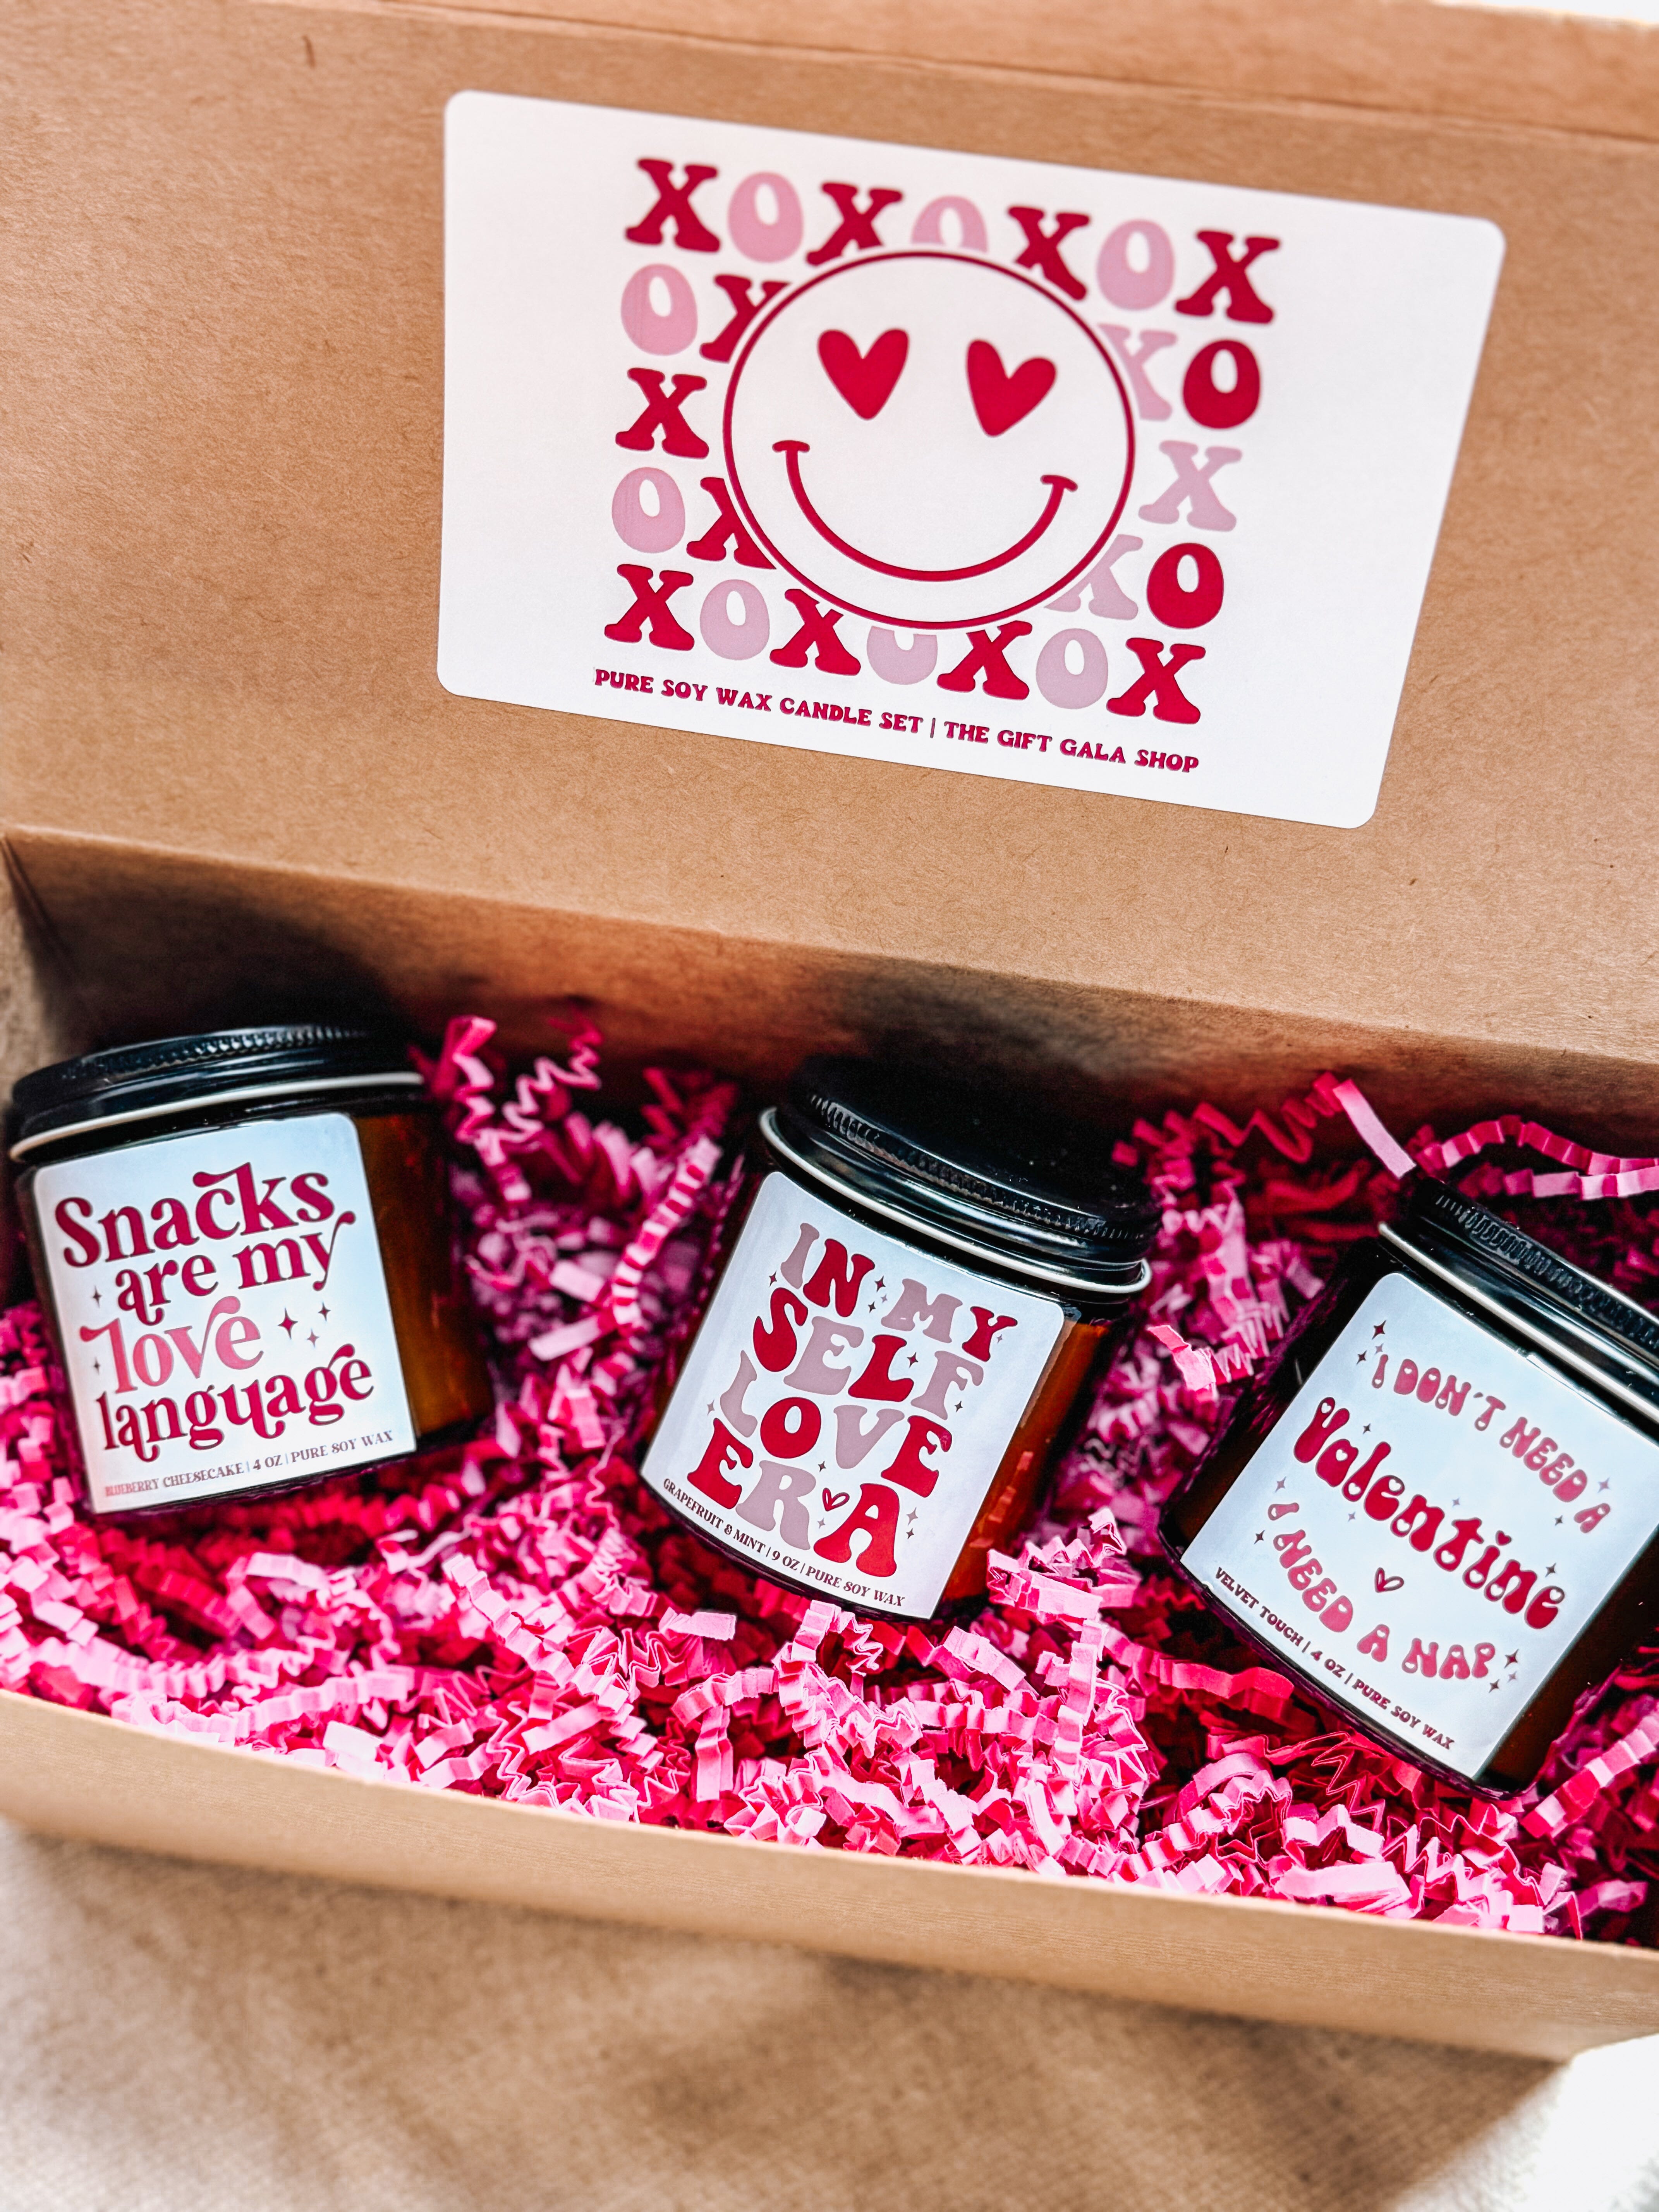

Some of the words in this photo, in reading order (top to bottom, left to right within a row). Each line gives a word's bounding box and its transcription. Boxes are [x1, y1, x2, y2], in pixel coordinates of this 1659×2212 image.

[615, 368, 709, 459] X
[1138, 440, 1243, 532] X
[595, 669, 654, 693] PURE
[661, 679, 708, 701] SOY
[716, 687, 772, 711] WAX
[780, 697, 872, 726] CANDLE
[879, 713, 923, 733] SET
[944, 721, 989, 744] THE
[997, 730, 1052, 752] GIFT
[1060, 739, 1126, 763] GALA
[1135, 749, 1199, 773] SHOP
[55, 1162, 335, 1268] Snacks
[115, 1251, 218, 1326] are
[234, 1211, 356, 1291] my
[80, 1296, 263, 1395] love
[781, 1223, 875, 1317] IN
[881, 1278, 1018, 1362] MY
[96, 1343, 374, 1463] language
[753, 1287, 984, 1419] SELF
[104, 1478, 159, 1496] BLUEBERRY
[163, 1462, 244, 1487] CHEESECAKE
[253, 1460, 261, 1470] 4
[265, 1455, 283, 1468] OZ
[291, 1445, 328, 1463] PURE
[331, 1439, 356, 1454] SOY
[362, 1431, 393, 1448] WAX
[720, 1350, 952, 1498] LOVE
[1371, 1354, 1389, 1389] I
[1394, 1358, 1506, 1431] DON'T
[1499, 1417, 1587, 1503] NEED
[1573, 1503, 1611, 1534] A
[664, 1478, 724, 1529] GRAPEFRUIT
[724, 1524, 733, 1535] &
[733, 1528, 766, 1553] MINT
[773, 1550, 780, 1561] 9
[783, 1557, 800, 1570] OZ
[805, 1566, 842, 1589] PURE
[843, 1582, 871, 1597] SOY
[874, 1589, 905, 1607] WAX
[687, 1418, 900, 1577] ERA
[1267, 1502, 1300, 1521] I
[1294, 1396, 1565, 1629] Valentine
[1273, 1529, 1353, 1633] NEED
[1215, 1567, 1259, 1609] VELVET
[1259, 1606, 1304, 1647] TOUCH
[1310, 1650, 1323, 1661] 4
[1324, 1658, 1347, 1678] OZ
[1352, 1679, 1391, 1710] PURE
[1390, 1705, 1421, 1728] SOY
[1421, 1724, 1455, 1750] WAX
[1357, 1624, 1390, 1662] A
[1401, 1638, 1496, 1680] NAP
